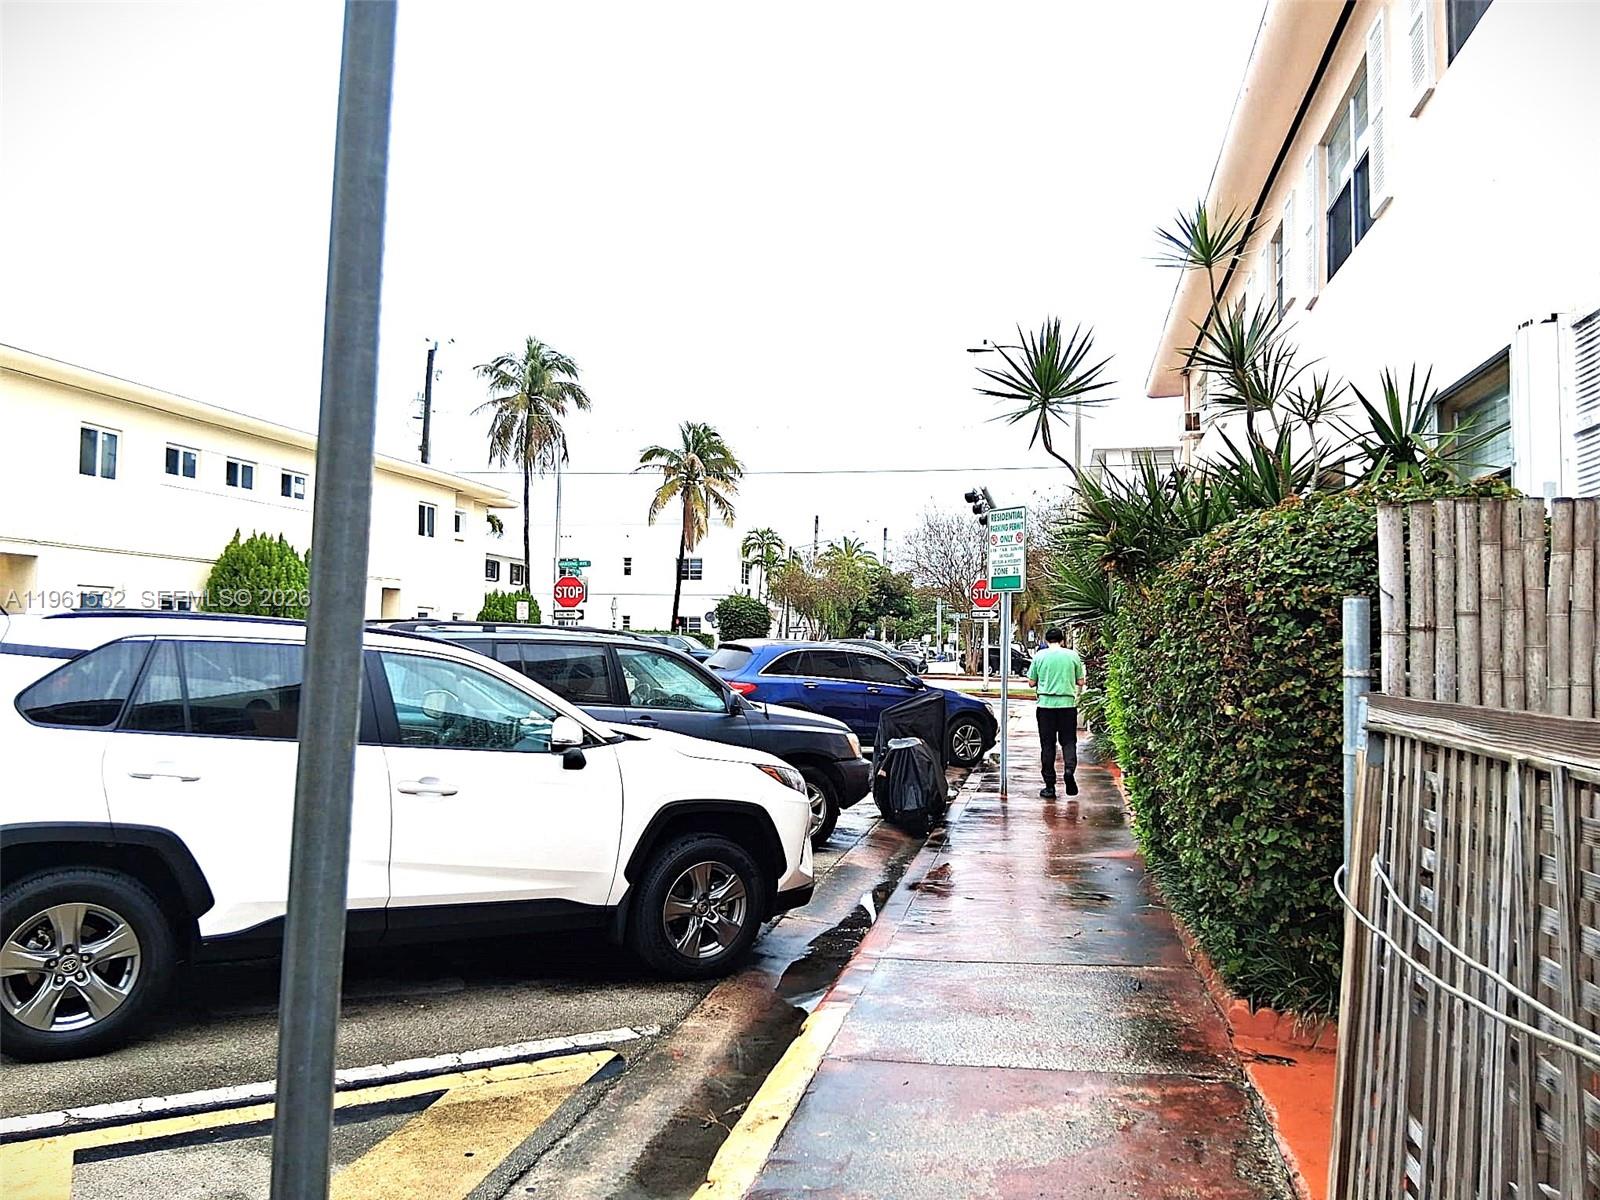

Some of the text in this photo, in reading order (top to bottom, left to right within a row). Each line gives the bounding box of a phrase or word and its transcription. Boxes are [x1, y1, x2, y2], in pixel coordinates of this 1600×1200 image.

[991, 511, 1023, 522] RESIDENTIAL
[1000, 535, 1013, 543] ONLY
[994, 567, 1009, 575] ZONE
[555, 586, 582, 598] STOP
